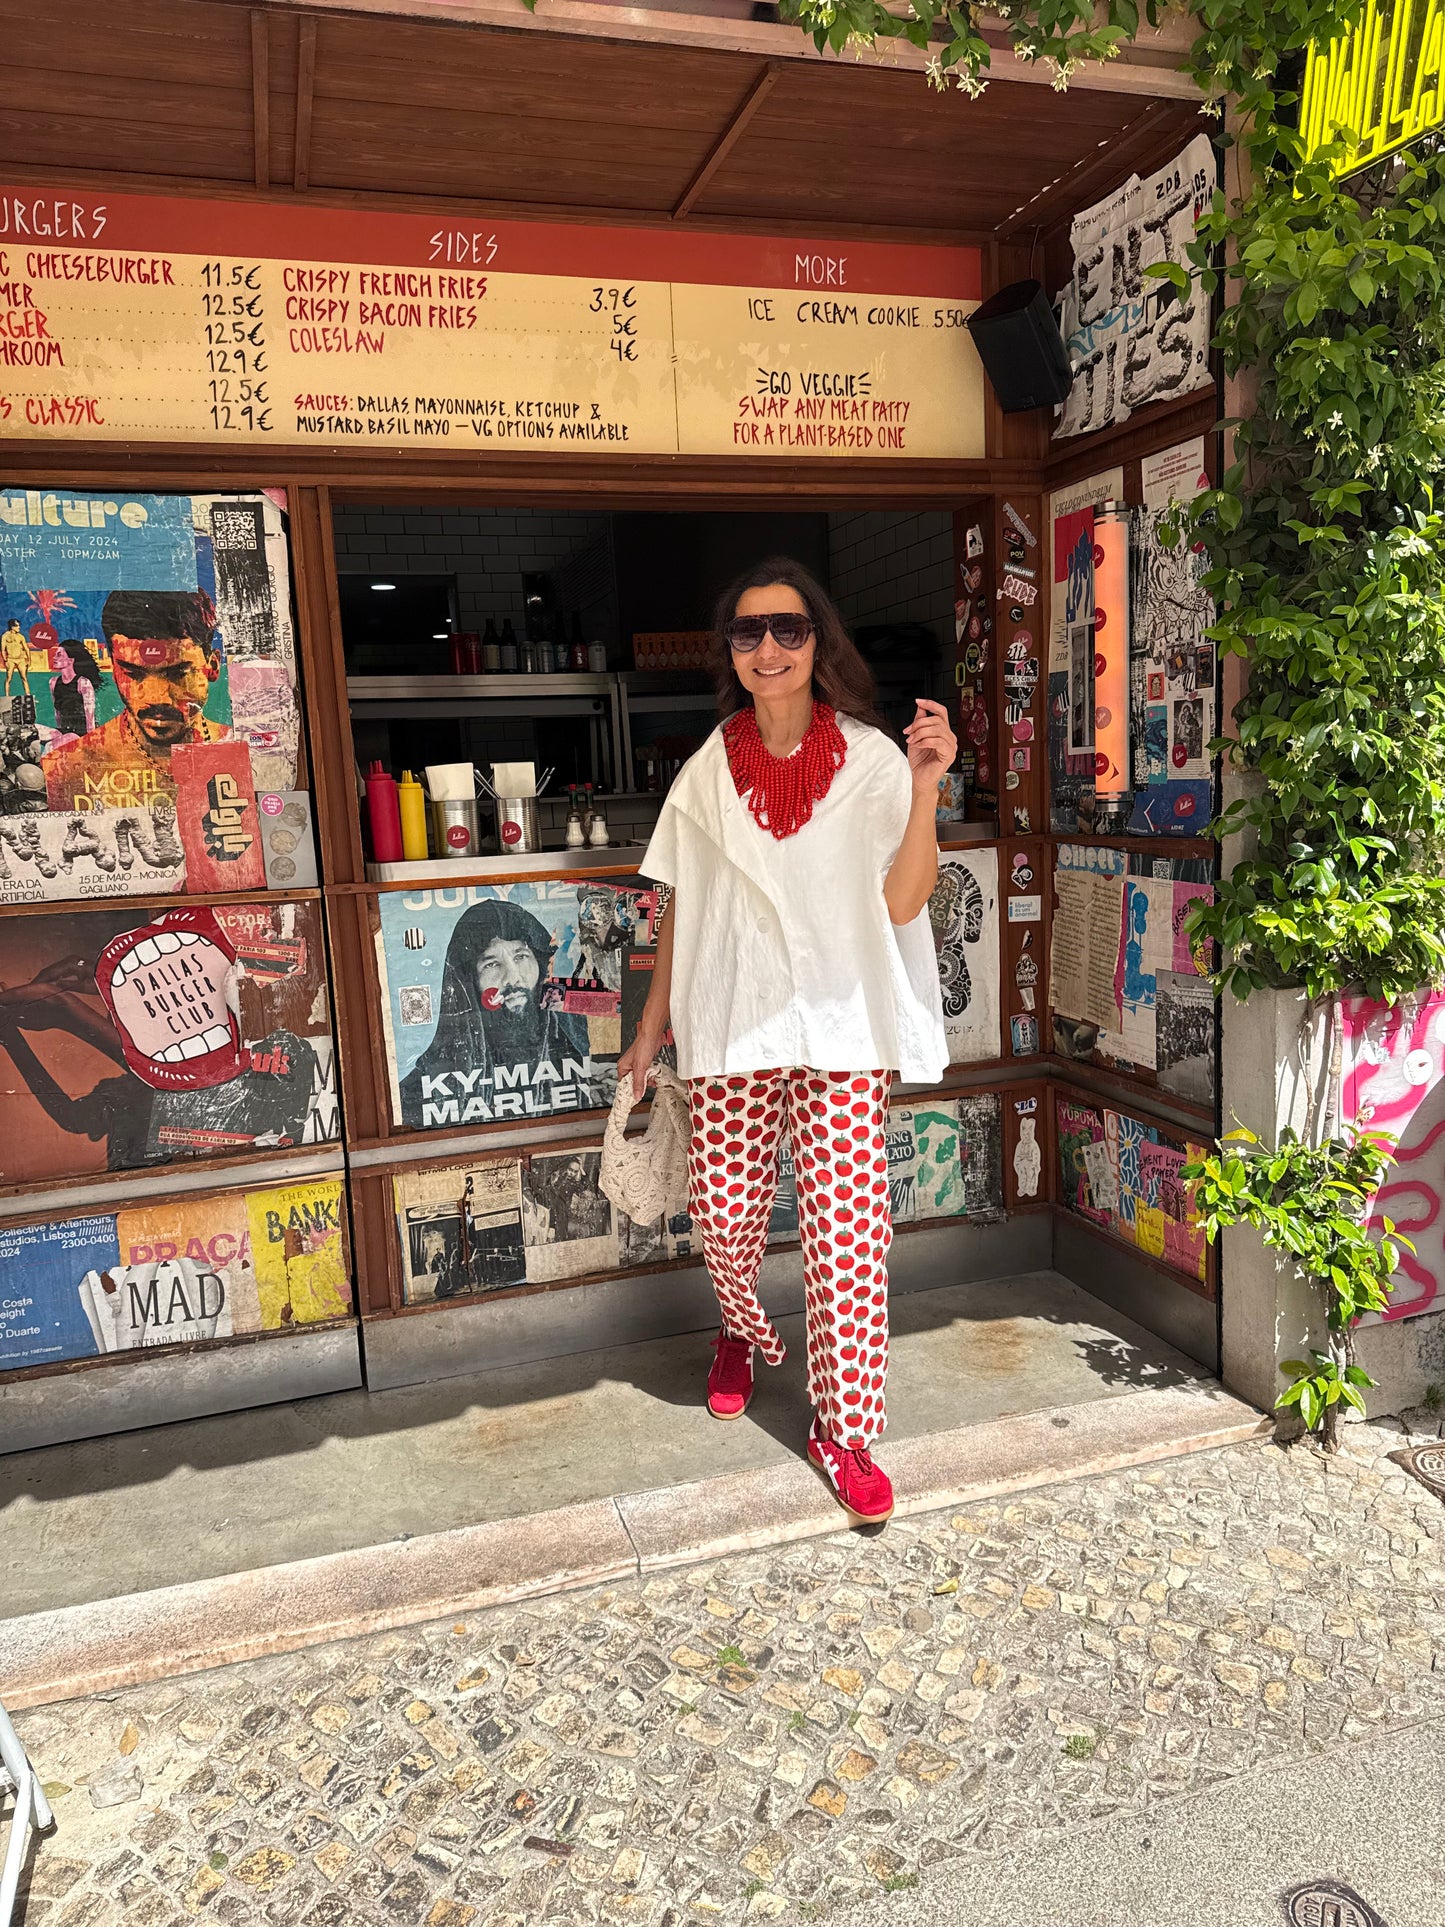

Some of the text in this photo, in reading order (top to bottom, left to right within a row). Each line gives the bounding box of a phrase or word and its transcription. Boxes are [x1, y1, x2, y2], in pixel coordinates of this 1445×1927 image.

[428, 230, 499, 264] SIDES
[26, 252, 175, 286] CHEESEBURGER
[201, 262, 261, 290] 11.5€
[795, 254, 847, 285] MORE
[283, 267, 637, 313] CRISPY FRENCH FRIES 3.9€
[202, 294, 263, 317] 12.5€
[285, 295, 637, 336] CRISPY BACON FRIES 5€
[748, 298, 775, 322] ICE
[797, 302, 858, 325] CREAM
[867, 306, 920, 328] COOKIE
[205, 321, 264, 347] 12.5€
[289, 327, 638, 362] COLESLAW 4€
[206, 349, 268, 375] 12.9€
[208, 379, 269, 404] 12.5€
[770, 371, 859, 397] GO VEGGIE
[26, 398, 104, 426] CLASSIC
[210, 404, 273, 431] 12.9€
[294, 393, 601, 420] SAUCES: DALLAS, MAYONNAISE, KETCHUP &
[739, 395, 910, 424] SWAP ANY MEAT PATTY
[368, 417, 411, 436] BASIL
[414, 419, 450, 436] MAYO
[471, 420, 493, 437] VG
[497, 421, 554, 440] OPTIONS
[559, 421, 629, 441] AVAILABLE
[733, 422, 906, 449] FOR A PLANT-BASED ONE
[28, 534, 42, 544] 12
[50, 535, 80, 546] JULY
[90, 536, 119, 547] 2024
[61, 549, 120, 561] 10PM/6AM
[84, 769, 161, 793] MOTEL
[3, 879, 42, 891] ERA DA
[79, 883, 129, 895] GAGLIANO
[80, 870, 177, 884] 15 DE MAIO MONICA
[0, 891, 48, 903] RTIFICIAL
[132, 953, 204, 997] DALLAS
[143, 976, 217, 1019] BURGER
[166, 1001, 214, 1035] CLUB
[421, 1056, 592, 1099] KY-MAN
[449, 1163, 473, 1171] LOCO
[281, 1191, 304, 1202] THE
[0, 1215, 114, 1238] Collective & Afterhours.
[0, 1230, 77, 1248] studios, Lisboa
[0, 1247, 20, 1258] 024
[61, 1234, 116, 1250] 2300-0400
[2, 1297, 33, 1309] Costa
[127, 1272, 225, 1330] MAD
[0, 1308, 26, 1320] eight
[6, 1326, 40, 1339] Duarte
[132, 1330, 207, 1349] ENTRADA LIVRE
